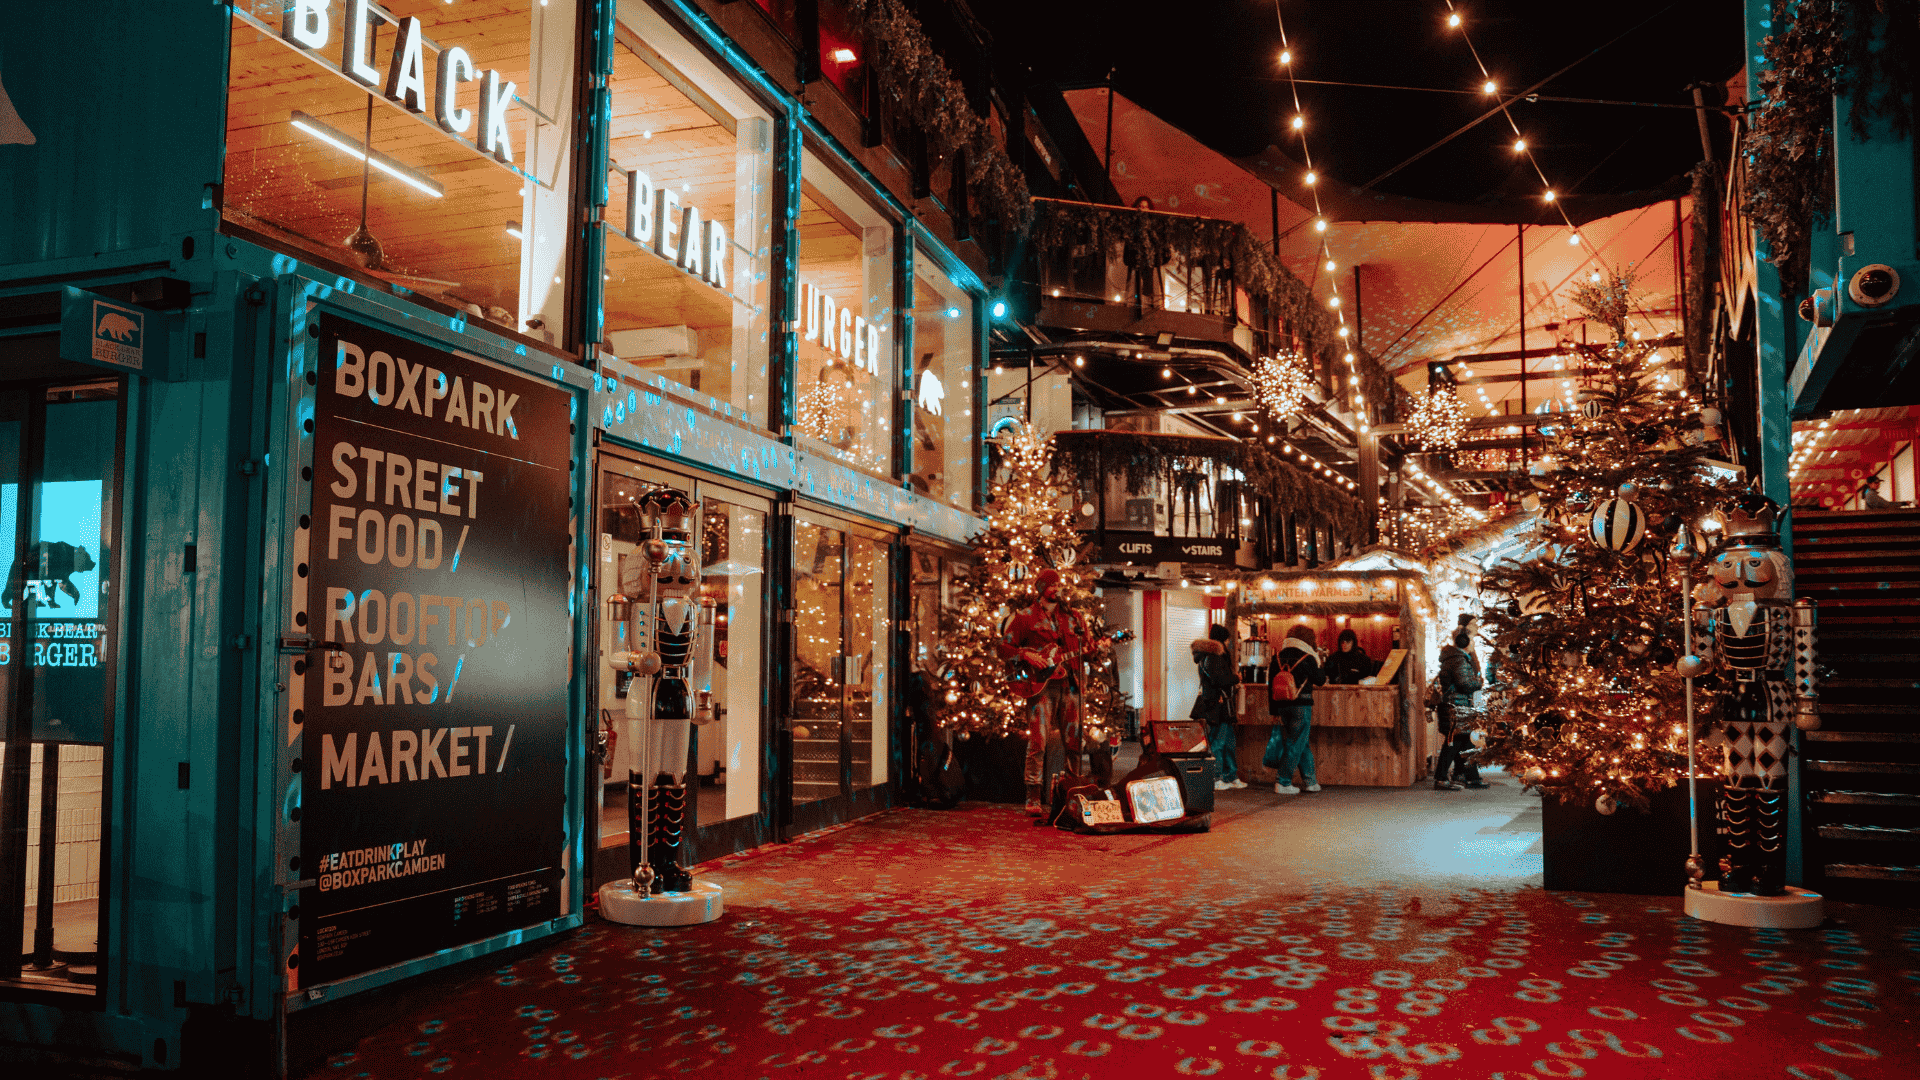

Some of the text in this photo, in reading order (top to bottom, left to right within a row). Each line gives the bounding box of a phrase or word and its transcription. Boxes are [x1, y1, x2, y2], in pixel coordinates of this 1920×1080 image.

[288, 0, 517, 163] BLACK
[630, 169, 726, 289] BEAR
[95, 347, 141, 366] BURGER
[335, 339, 520, 441] BOXPARK
[330, 441, 484, 520] STREET
[328, 504, 443, 570] FOOD
[1126, 543, 1153, 554] LIFTS
[1191, 545, 1223, 556] STAIRS
[1270, 586, 1363, 598] WINTER WARMERS
[53, 622, 98, 639] BEAR
[324, 586, 512, 648] ROOFTOP
[0, 642, 97, 667] BRGER
[322, 650, 439, 707] BARS
[321, 725, 493, 790] MARKET
[319, 838, 427, 873] #EATDRINKPLAY
[319, 853, 446, 892] @BOXPARKCAMDEN
